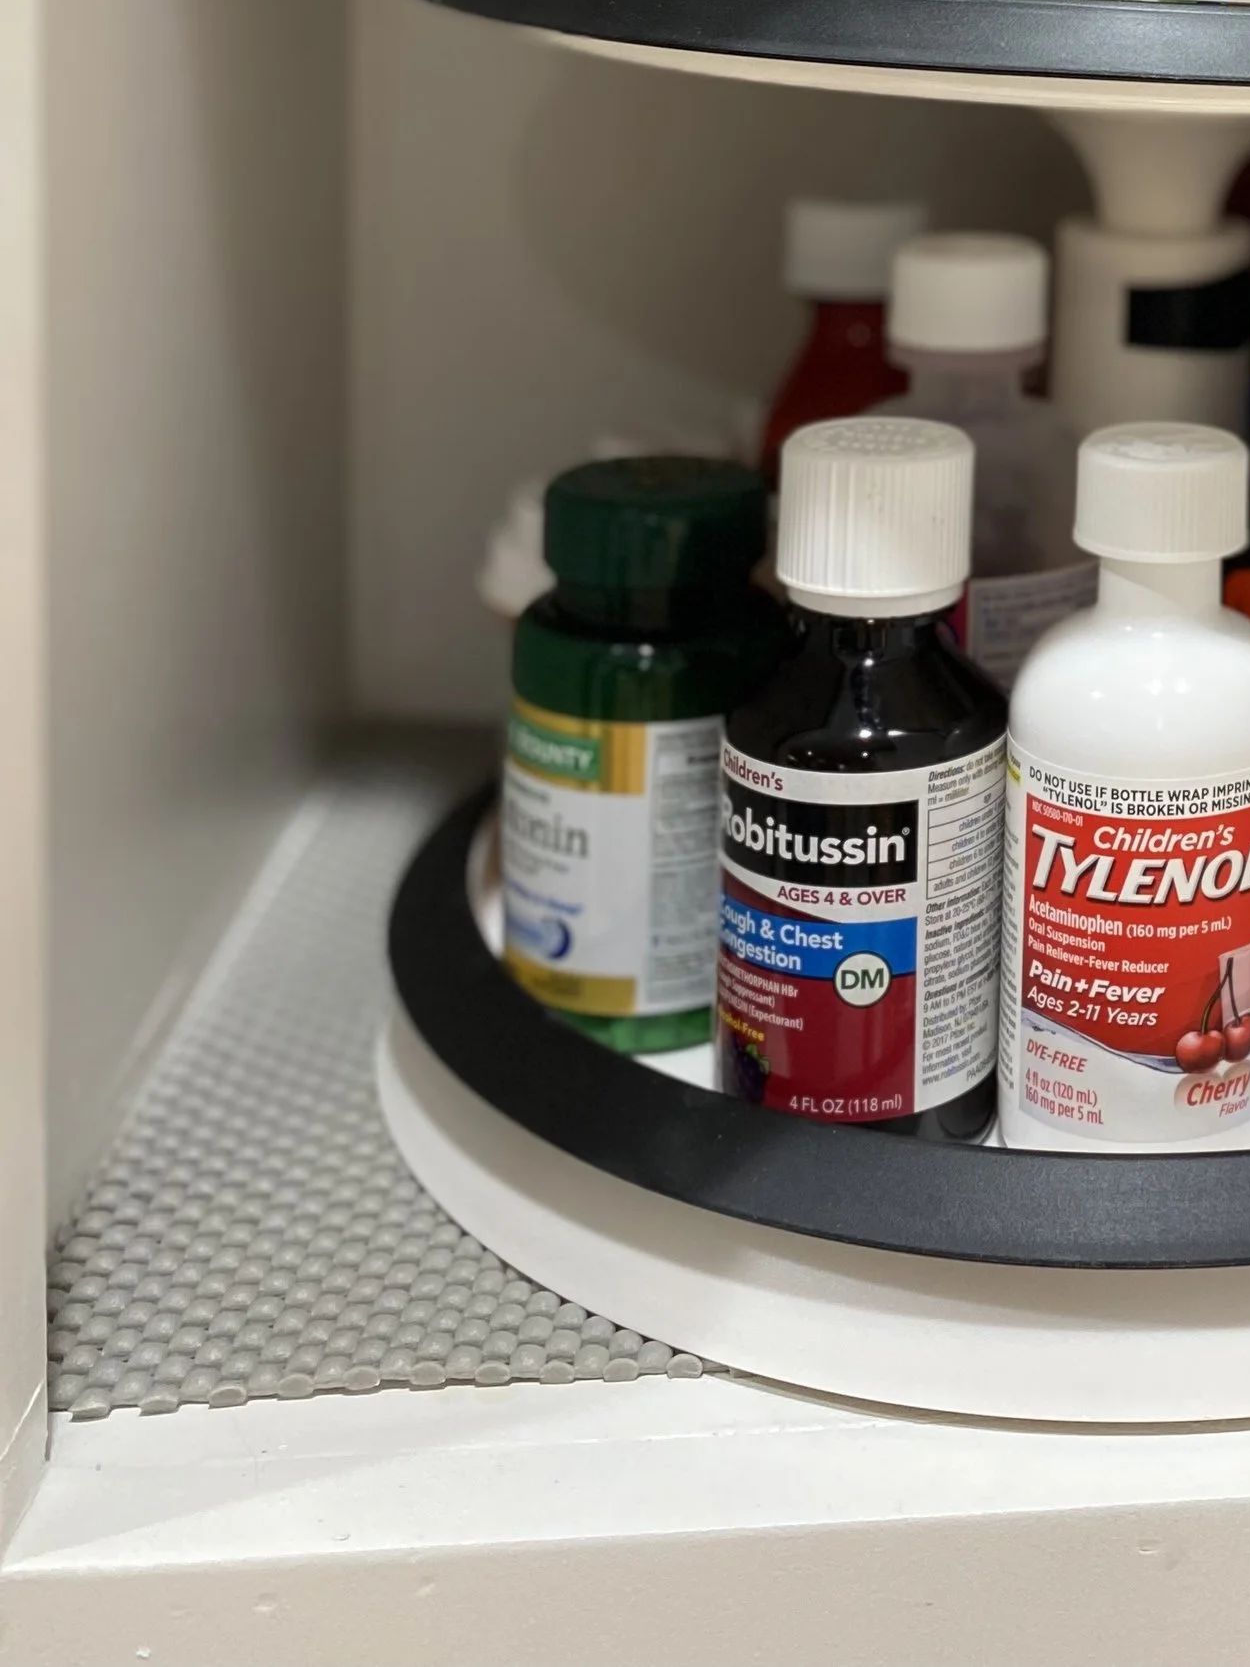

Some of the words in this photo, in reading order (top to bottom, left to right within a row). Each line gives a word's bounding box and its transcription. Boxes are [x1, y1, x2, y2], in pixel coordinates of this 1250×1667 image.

[724, 748, 783, 791] Children's
[1030, 766, 1042, 781] DO
[1045, 773, 1066, 789] NOT
[1069, 781, 1092, 796] USE
[1096, 786, 1107, 798] IF
[1111, 788, 1163, 802] BOTTLE
[1168, 788, 1209, 802] WRAP
[1032, 799, 1042, 811] NDC
[1111, 802, 1123, 814] IS
[1128, 803, 1184, 816] BROKEN
[1189, 802, 1208, 814] OR
[1093, 824, 1234, 853] Children's
[778, 887, 819, 904] AGES
[824, 892, 834, 904] 4
[839, 892, 852, 905] &
[857, 889, 906, 905] OVER
[1029, 894, 1122, 936] Acetaminophen
[1127, 925, 1153, 938] (160
[1157, 927, 1176, 939] mg
[1179, 924, 1199, 938] per
[1202, 921, 1209, 934] 5
[1211, 916, 1232, 931] mL)
[760, 919, 775, 940] &
[780, 924, 843, 949] Chest
[1029, 917, 1045, 935] Oral
[1047, 926, 1105, 952] Suspension
[1028, 935, 1045, 954] Pain
[1046, 944, 1120, 972] Reliever-Fever
[1122, 961, 1169, 973] Reducer
[781, 985, 799, 998] HBr
[840, 968, 884, 990] DM
[1029, 959, 1165, 1004] Pain+Fever
[749, 1005, 803, 1030] (Expectorant)
[1028, 986, 1064, 1012] Ages
[1067, 1000, 1100, 1021] 2-11
[1107, 1008, 1158, 1026] Years
[1026, 1038, 1088, 1073] DYE-FREE
[1025, 1068, 1031, 1083] 4
[1032, 1072, 1039, 1085] fl
[1041, 1077, 1051, 1088] oz
[1053, 1080, 1074, 1101] (120
[1076, 1090, 1097, 1108] mL)
[790, 1095, 798, 1110] 4
[802, 1097, 818, 1112] FL
[822, 1099, 845, 1114] OZ
[848, 1096, 878, 1115] (118
[882, 1094, 902, 1112] ml)
[1025, 1085, 1038, 1105] 160
[1040, 1095, 1055, 1113] mg
[1058, 1101, 1074, 1118] per
[1078, 1106, 1084, 1121] 5
[1087, 1109, 1104, 1125] mL
[1219, 1096, 1250, 1118] Flavor
